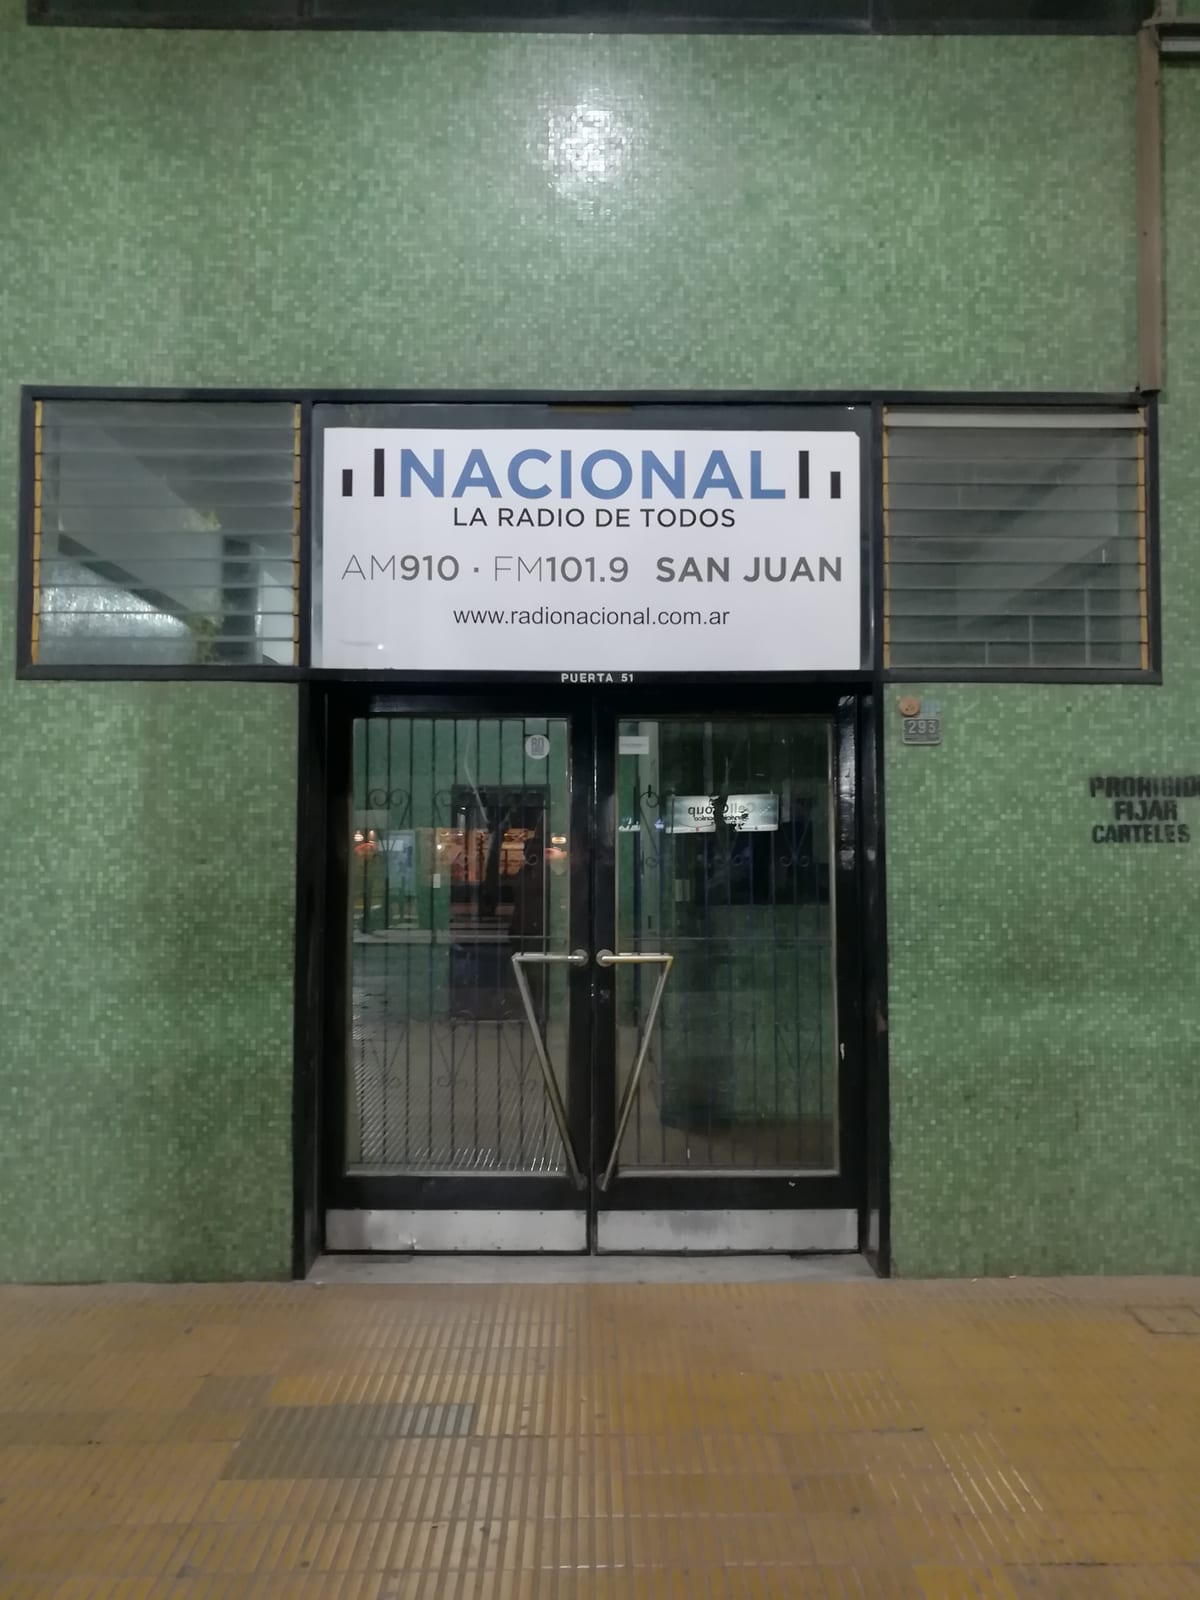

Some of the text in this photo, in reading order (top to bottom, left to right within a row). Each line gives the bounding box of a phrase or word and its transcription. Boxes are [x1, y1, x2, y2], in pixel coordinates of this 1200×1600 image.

[400, 448, 786, 500] NACIONAL
[453, 507, 736, 528] LA RADIO DE TODOS
[341, 554, 842, 583] AM910 FM101.9 SAN JUAN
[453, 606, 730, 626] www.radionacional.com.ar
[560, 672, 634, 684] PUERTA 51
[908, 720, 936, 734] 293
[1089, 775, 1200, 798] PROHIBID
[1114, 799, 1178, 821] FIJAR
[1092, 824, 1191, 843] CARTELES
